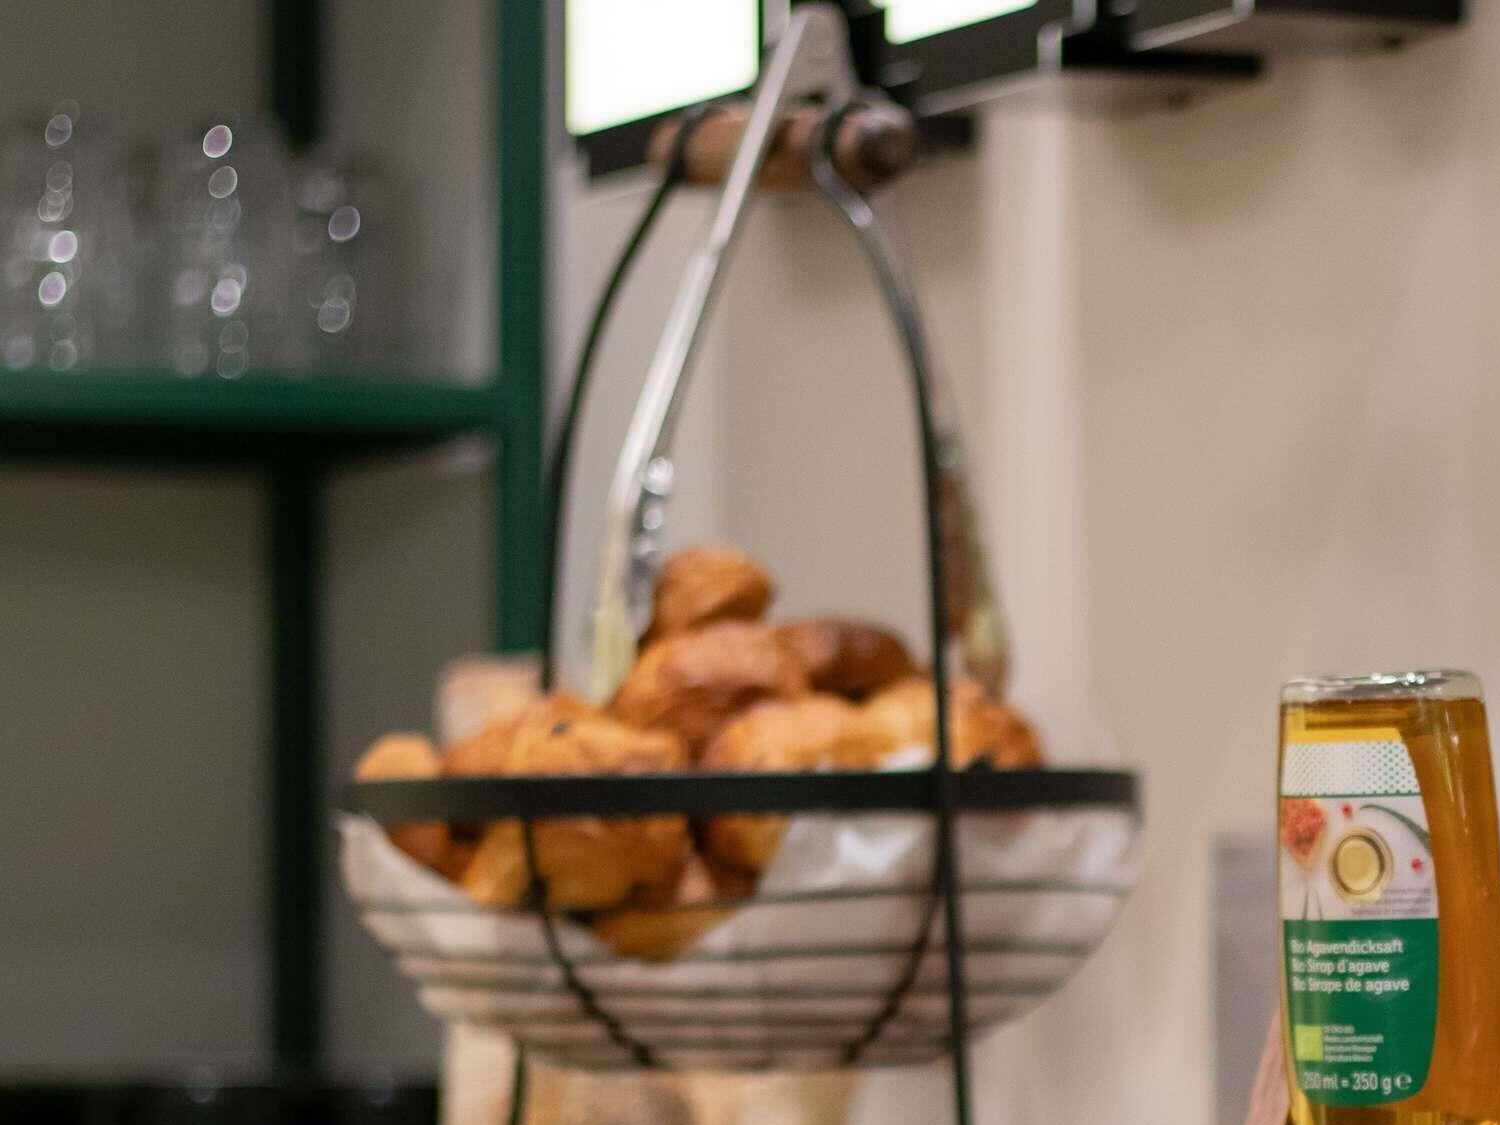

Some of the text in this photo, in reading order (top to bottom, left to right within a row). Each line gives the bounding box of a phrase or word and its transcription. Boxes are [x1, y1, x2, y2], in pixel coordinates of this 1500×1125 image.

[1307, 939, 1404, 958] Agavendicksaft
[1307, 958, 1333, 976] Sirop
[1308, 977, 1342, 994] Sirope
[1345, 977, 1362, 992] de
[1365, 978, 1410, 995] agave
